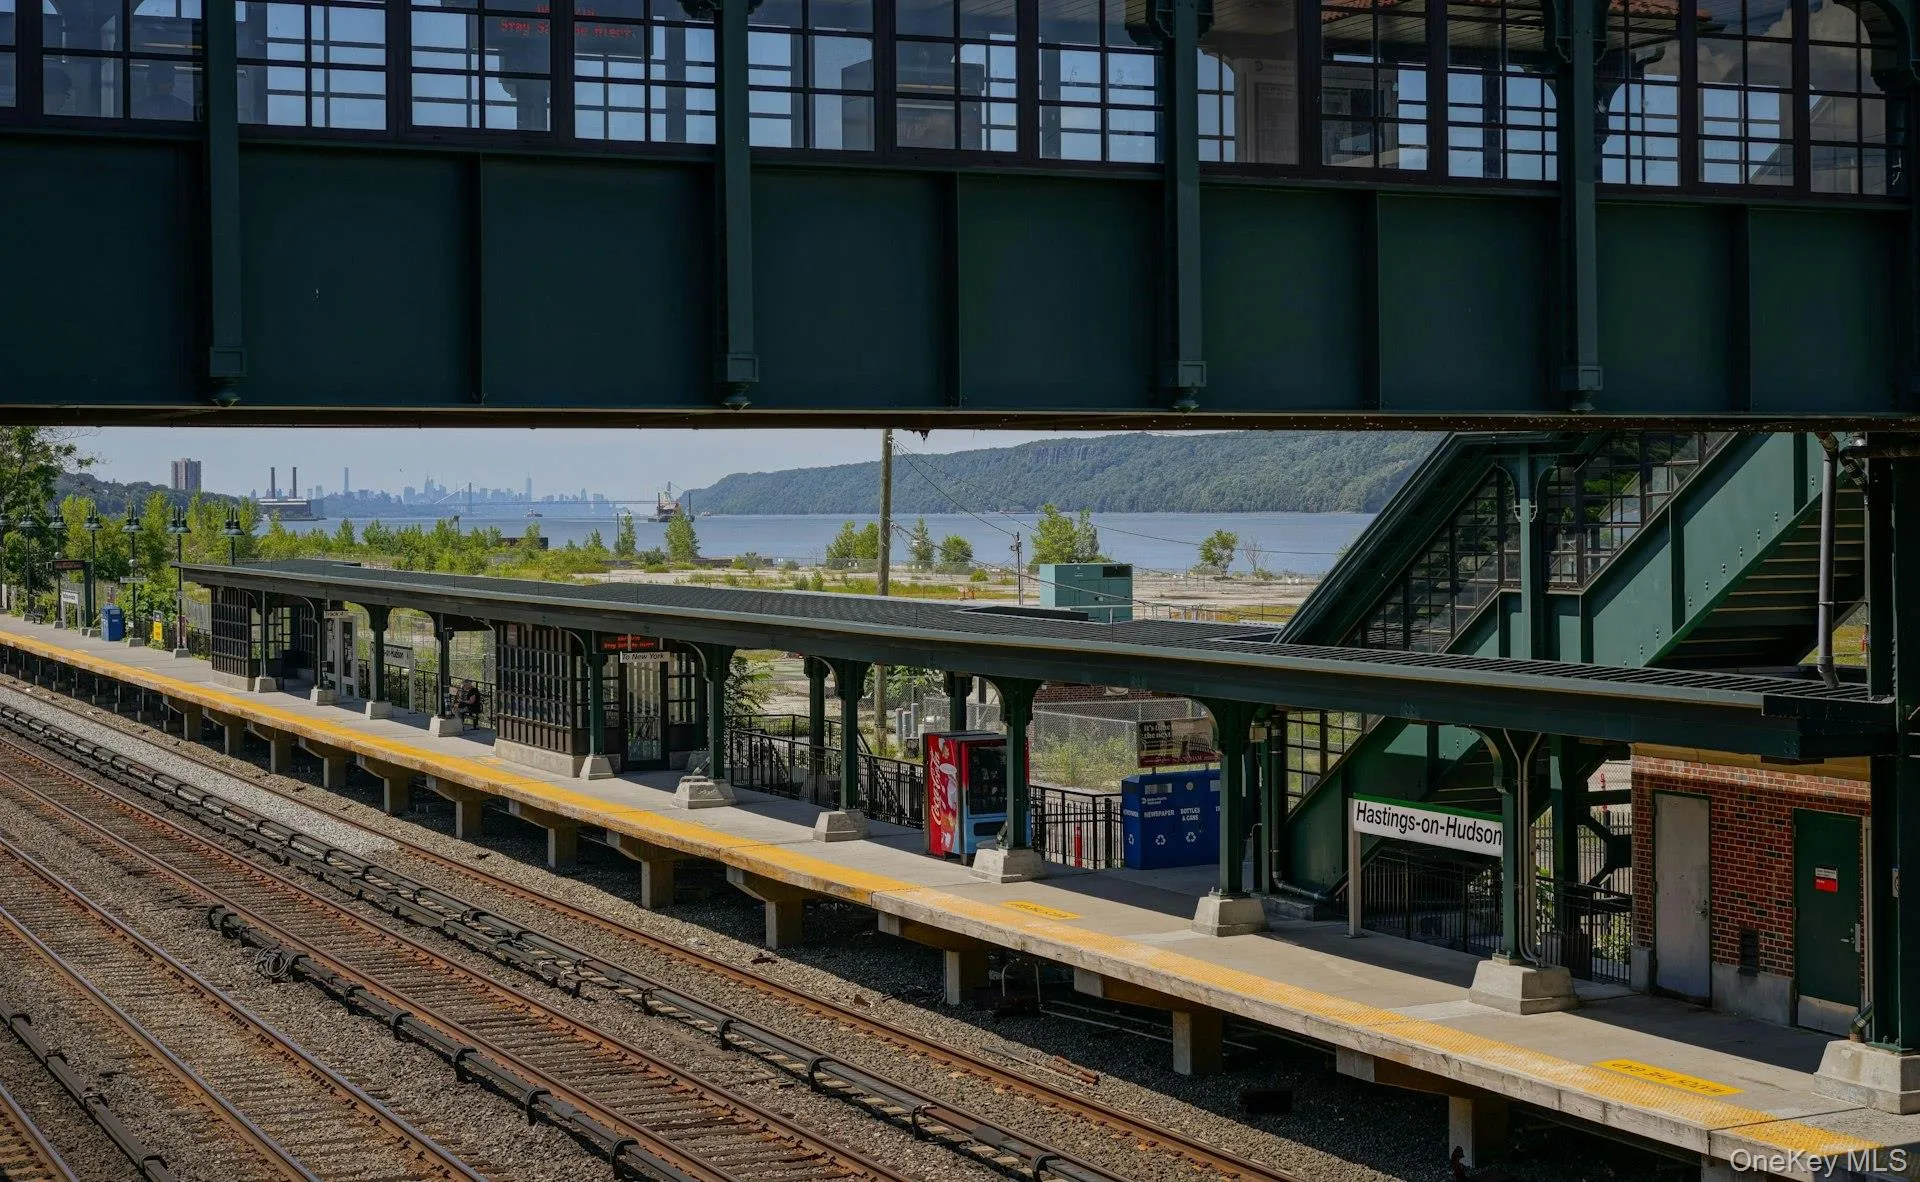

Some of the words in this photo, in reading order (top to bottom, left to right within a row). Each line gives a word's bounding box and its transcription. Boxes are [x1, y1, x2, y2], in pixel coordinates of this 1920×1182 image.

[650, 652, 665, 660] York
[930, 746, 942, 826] Coca-Cola
[1143, 809, 1175, 818] NEWSPAPER
[1180, 807, 1200, 815] BOTTLES
[1356, 801, 1502, 846] Hastings-on-Hudson
[1611, 1063, 1646, 1073] GAP
[1648, 1072, 1671, 1081] THE
